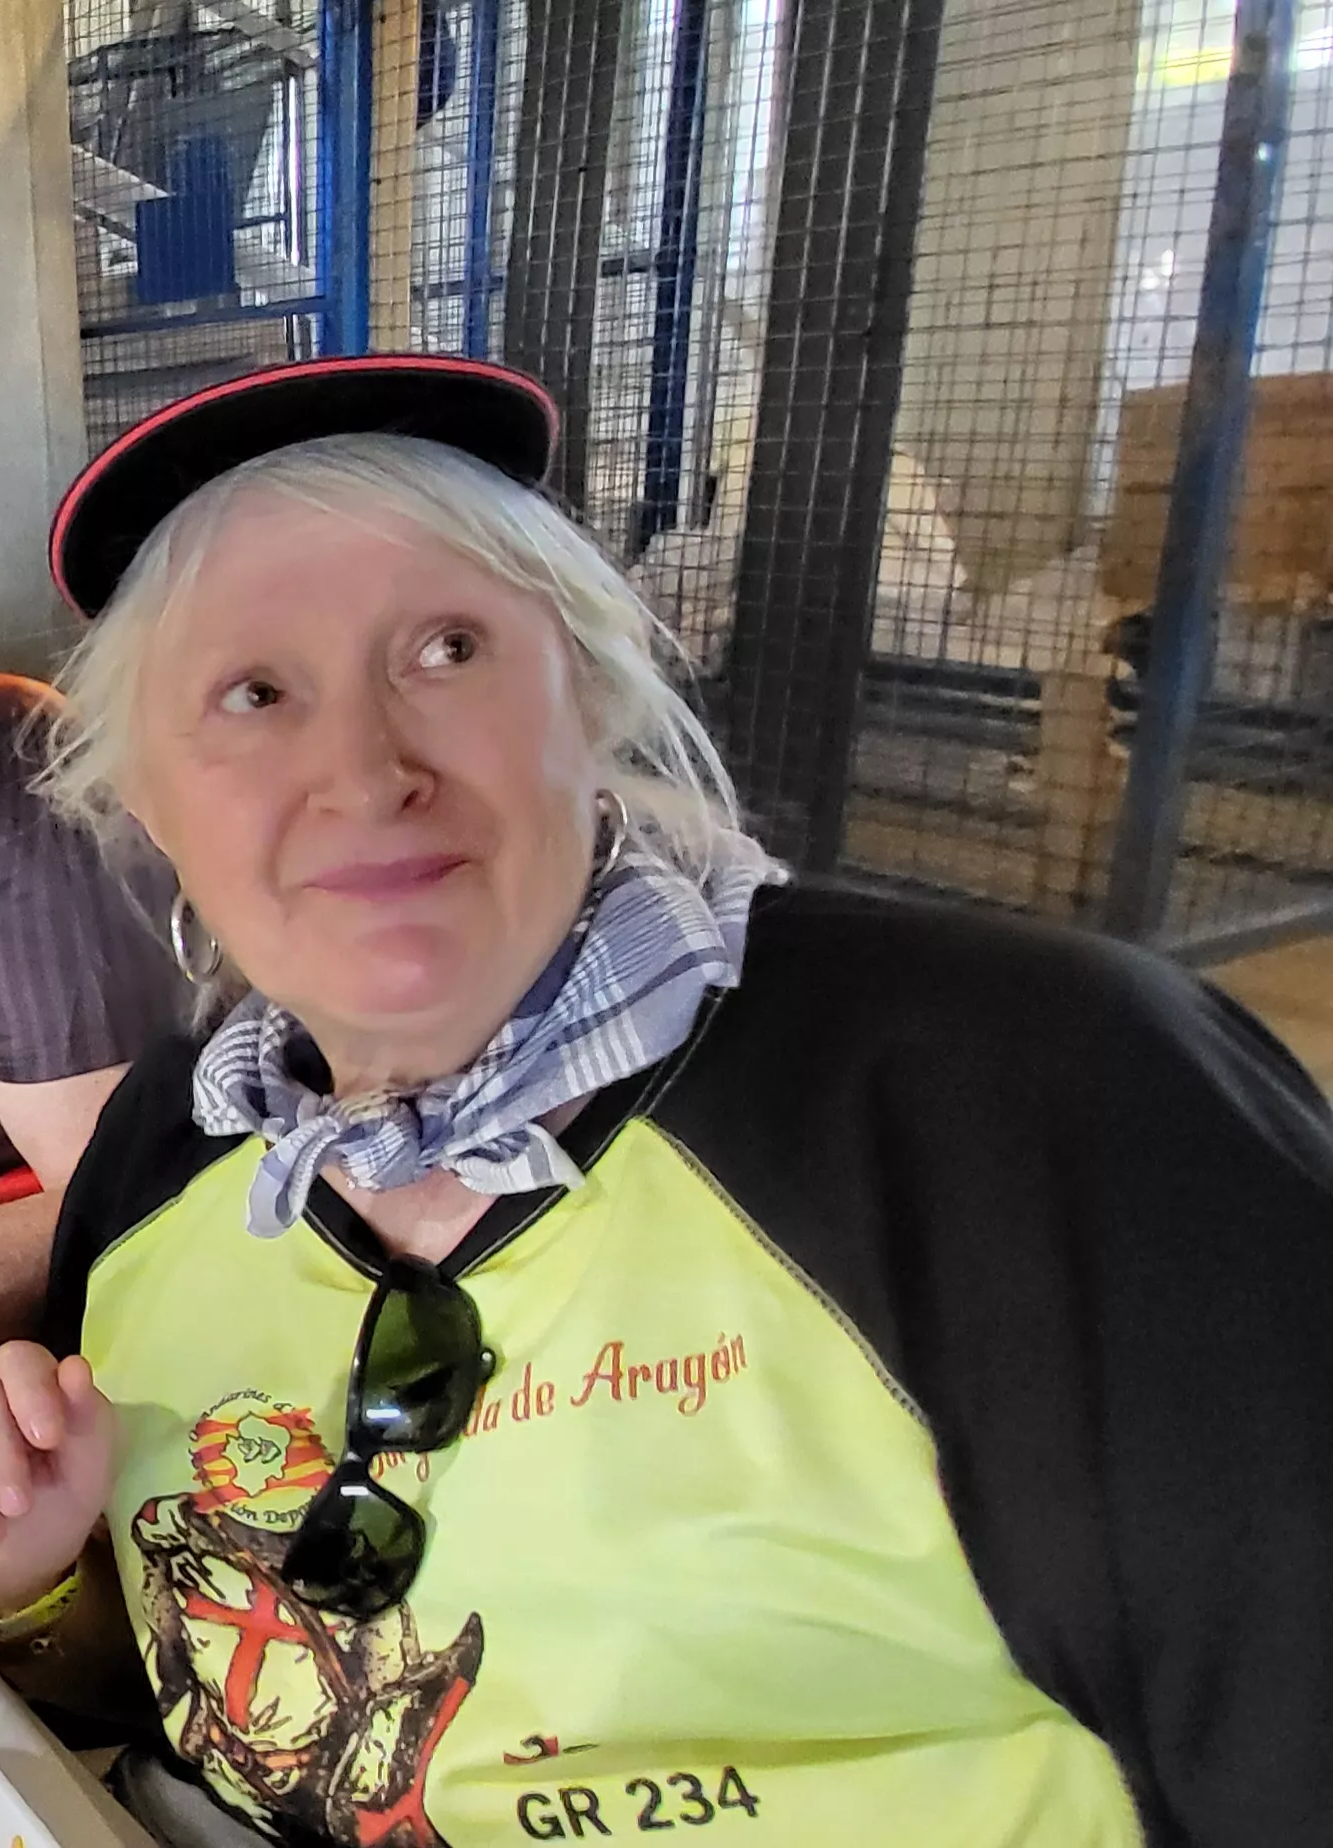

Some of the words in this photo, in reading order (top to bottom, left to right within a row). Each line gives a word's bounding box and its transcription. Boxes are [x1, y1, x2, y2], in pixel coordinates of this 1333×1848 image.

[511, 1361, 555, 1422] de
[517, 1786, 612, 1840] GR
[624, 1764, 760, 1831] 234
